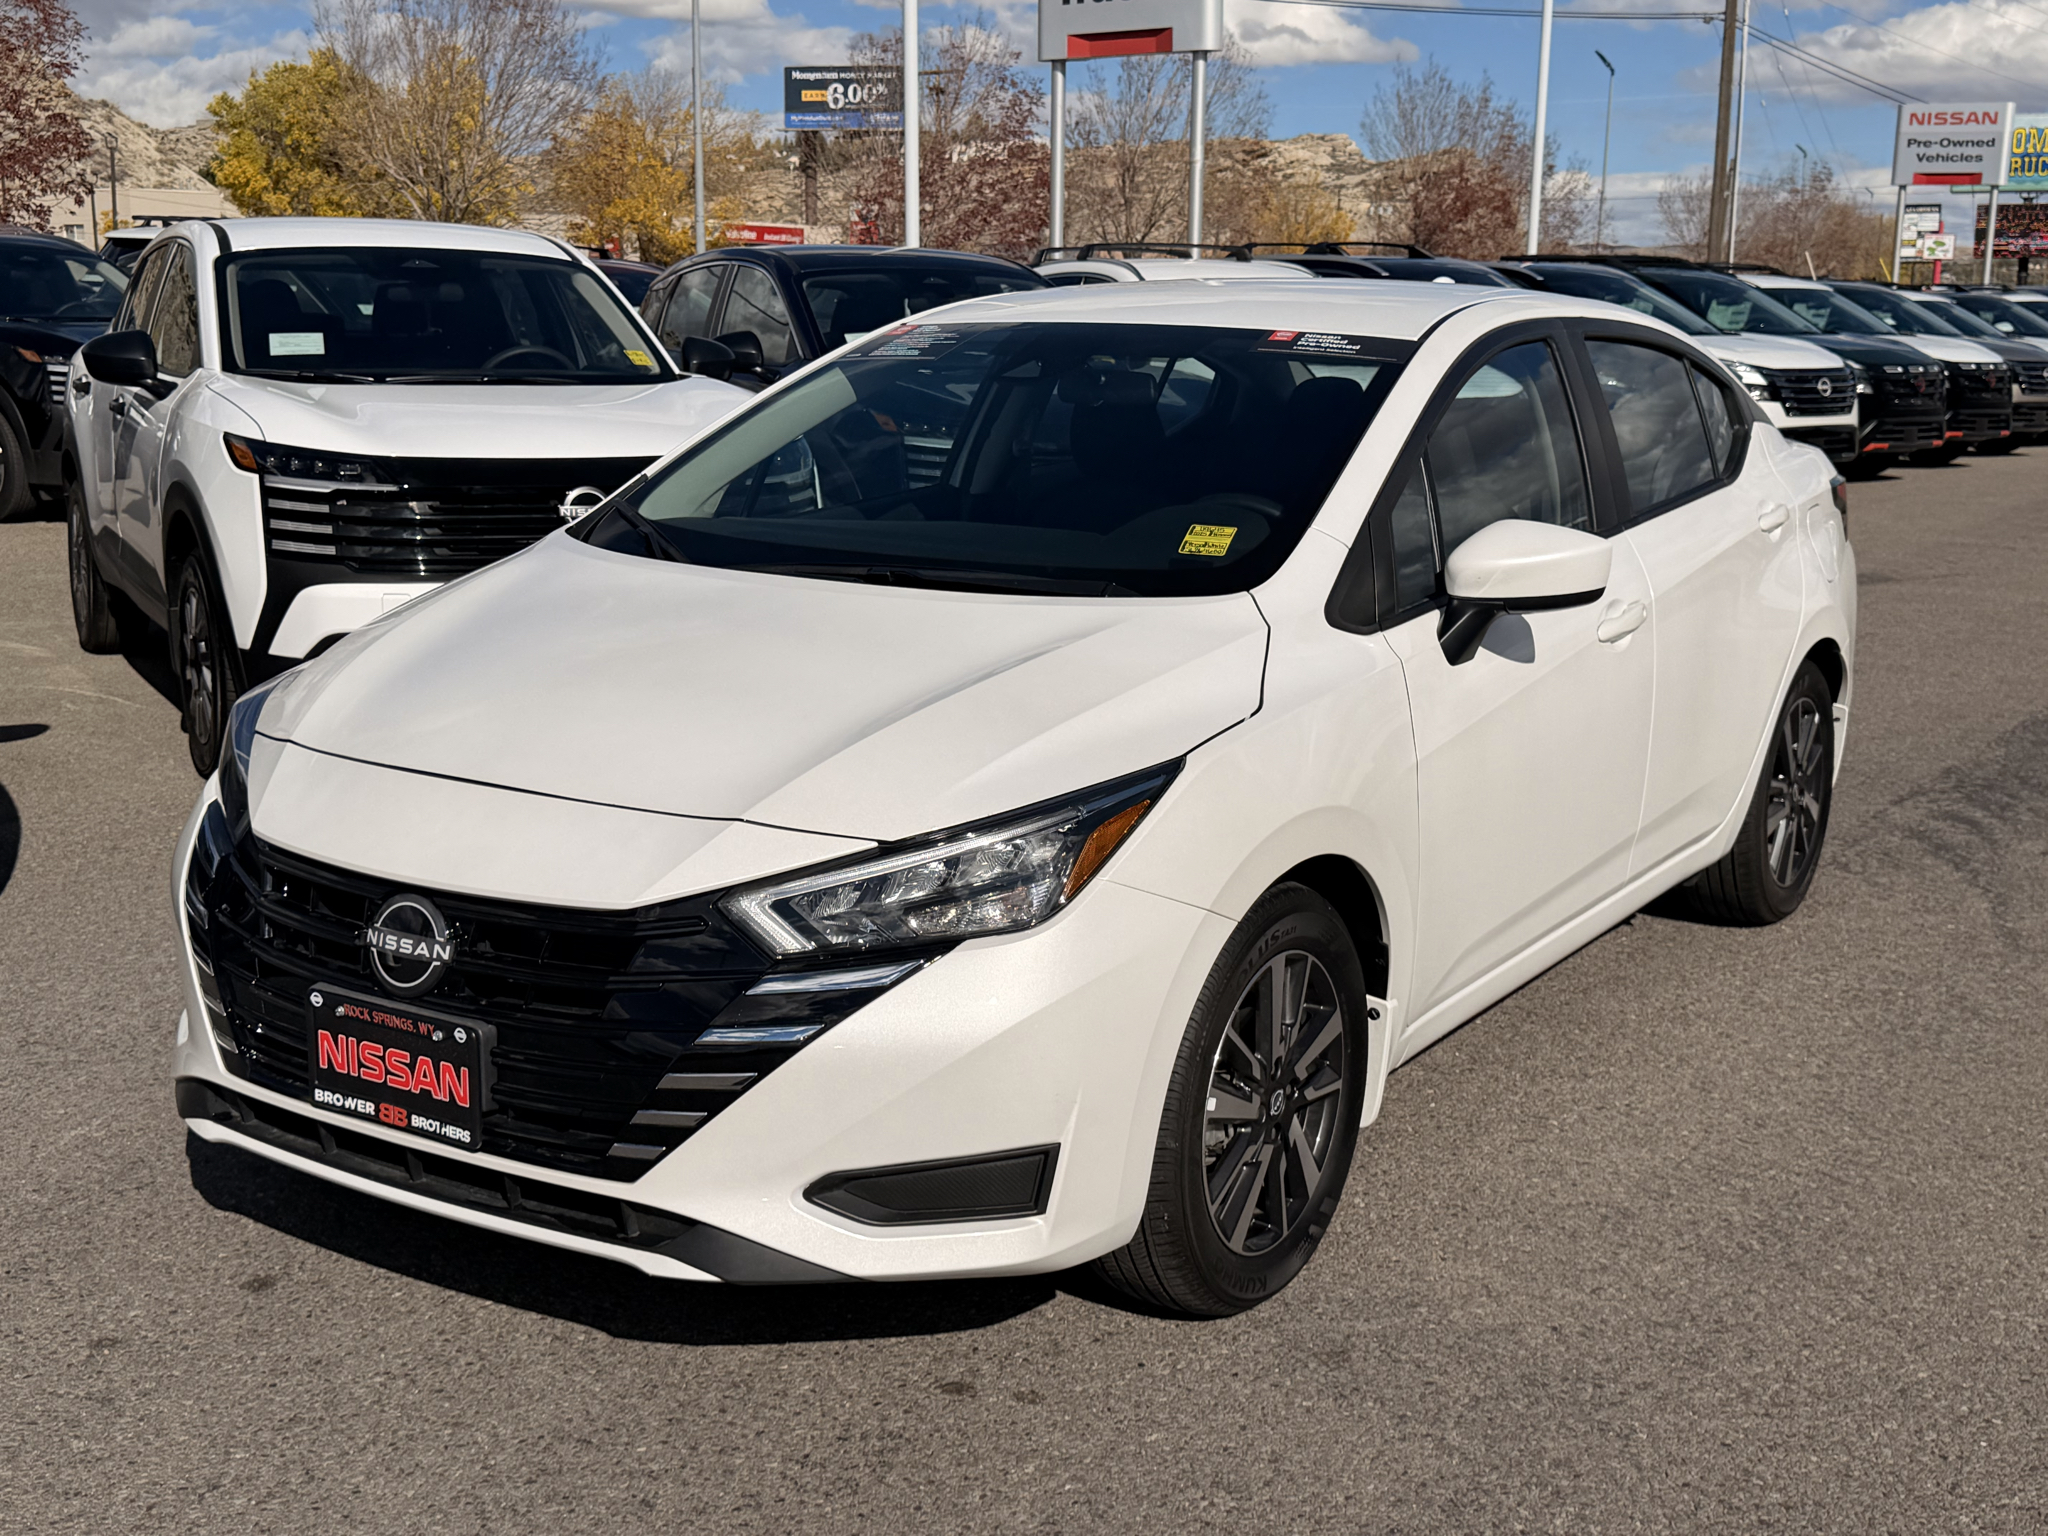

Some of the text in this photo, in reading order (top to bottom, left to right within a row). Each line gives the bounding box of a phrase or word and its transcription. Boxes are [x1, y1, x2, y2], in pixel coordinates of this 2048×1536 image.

[1909, 111, 1999, 126] NISSAN
[1907, 138, 1995, 148] Pre-Owned
[1916, 153, 1983, 163] Vehicles
[1297, 341, 1361, 350] Pre-Owned
[1300, 337, 1349, 345] Certified
[560, 508, 593, 516] NIS
[366, 928, 450, 960] NISSAN
[343, 1003, 370, 1021] ROCK
[418, 1021, 435, 1036] WY
[317, 1029, 470, 1108] NISSAN
[314, 1088, 375, 1115] BROWER
[411, 1114, 471, 1143] BROTHERS
